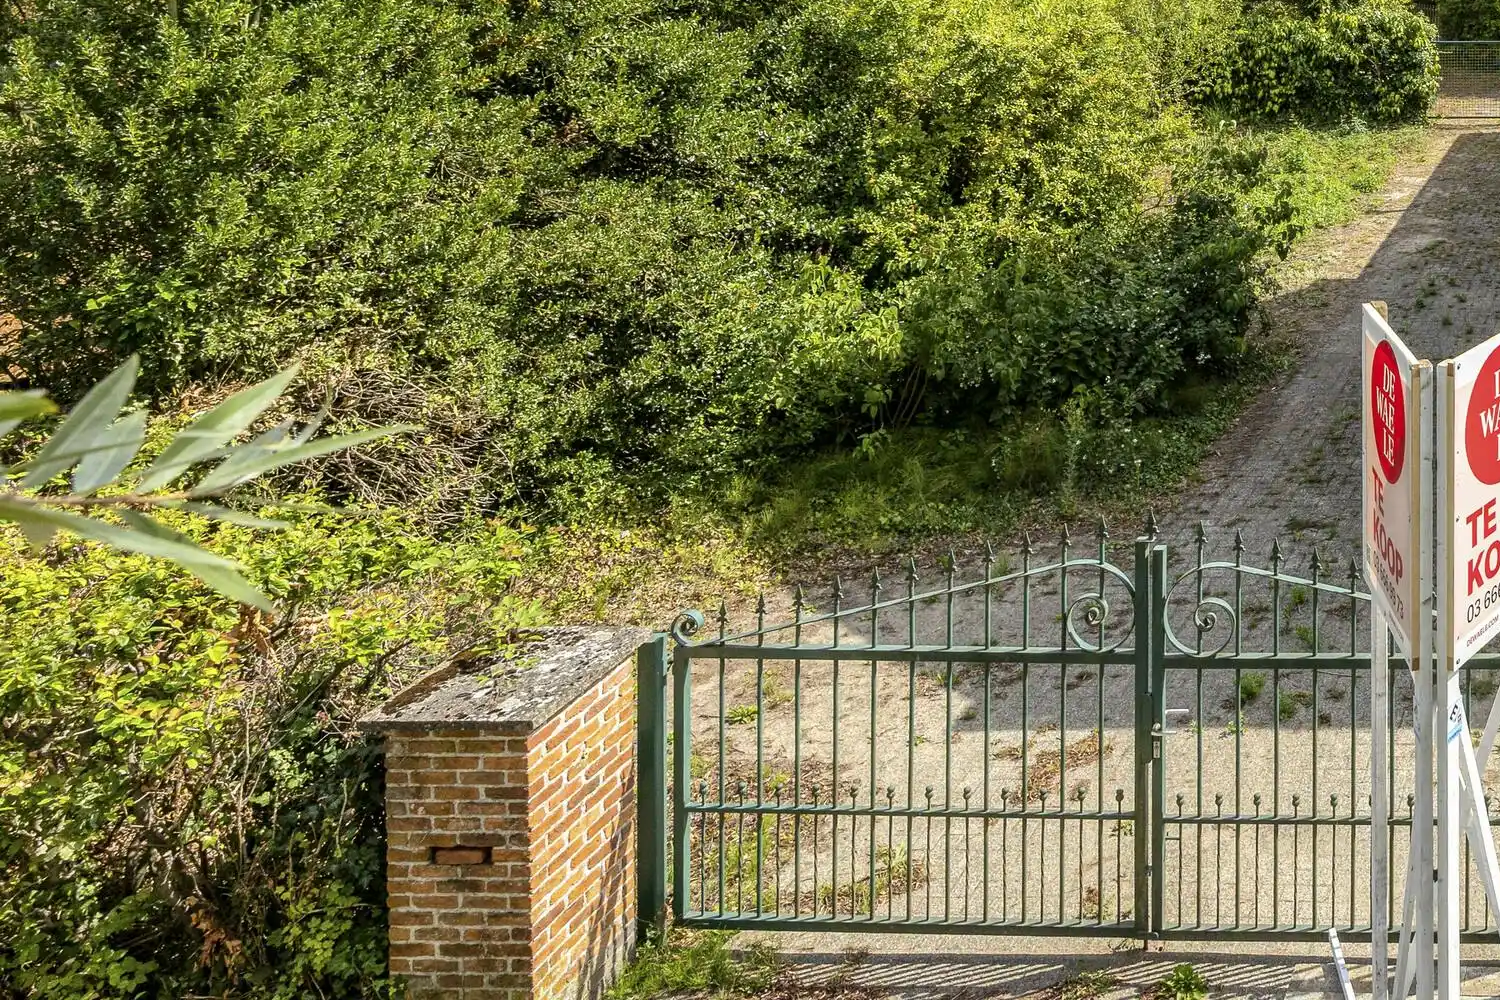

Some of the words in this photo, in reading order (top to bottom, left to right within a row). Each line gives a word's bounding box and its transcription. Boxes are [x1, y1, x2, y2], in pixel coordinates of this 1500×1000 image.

[1383, 363, 1395, 402] DE
[1376, 386, 1395, 434] WAE
[1383, 428, 1395, 467] LE
[1372, 465, 1384, 517] TE
[1466, 497, 1497, 548] TE
[1373, 508, 1403, 585] KOOP
[1466, 614, 1500, 647] DEWAELE.COM
[1467, 599, 1481, 623] 03
